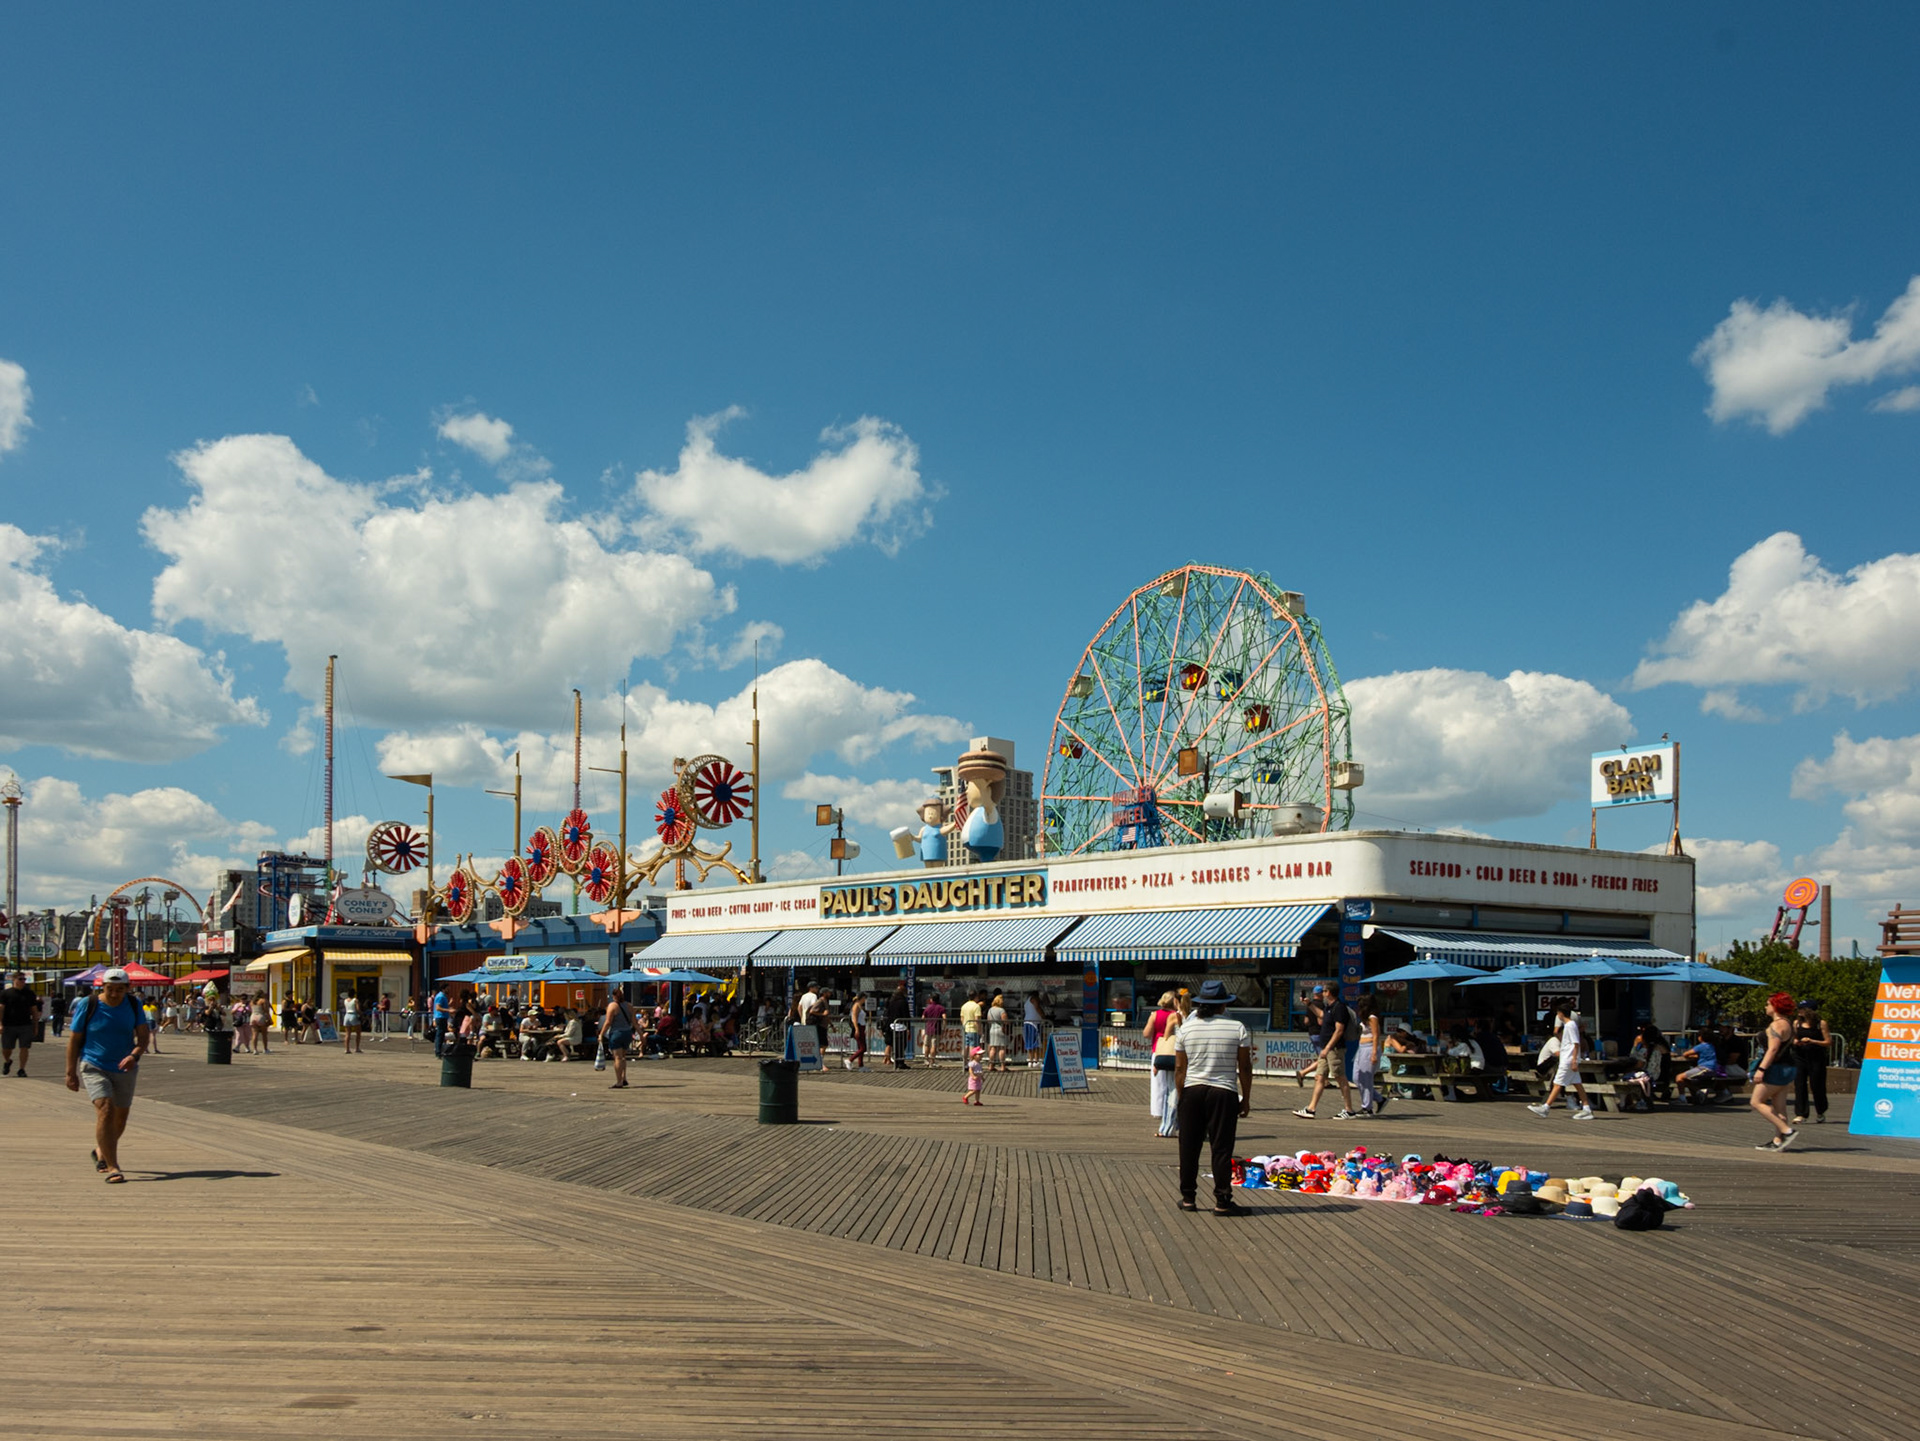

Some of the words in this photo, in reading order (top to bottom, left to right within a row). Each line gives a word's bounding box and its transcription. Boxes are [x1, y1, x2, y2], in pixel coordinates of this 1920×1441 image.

[1599, 754, 1661, 777] CLAM
[1607, 774, 1655, 795] BAR
[1113, 806, 1147, 826] WHEEL
[1053, 876, 1127, 893] FRANKFURTERS
[1142, 872, 1174, 888] PIZZA
[1191, 867, 1250, 884] SAUSAGES
[1270, 863, 1302, 880] CLAM
[1308, 861, 1332, 877] BAR
[1410, 860, 1461, 878] SEAFOOD
[1476, 865, 1503, 881] COLD
[1509, 868, 1536, 884] BEER
[1541, 871, 1547, 885] &
[1553, 871, 1578, 887] SODA
[1592, 874, 1627, 891] FRENCH
[1632, 878, 1658, 893] FRIES
[820, 886, 894, 916] PAUL'S
[900, 874, 1044, 910] DAUGHTER
[672, 909, 686, 919] FRIES
[692, 907, 705, 918] COLD
[708, 906, 722, 917] BEER
[729, 903, 750, 915] COTTON
[754, 902, 773, 913] CANDY
[780, 900, 790, 911] ICE
[795, 898, 816, 909] CREAM
[1881, 1024, 1907, 1038] for
